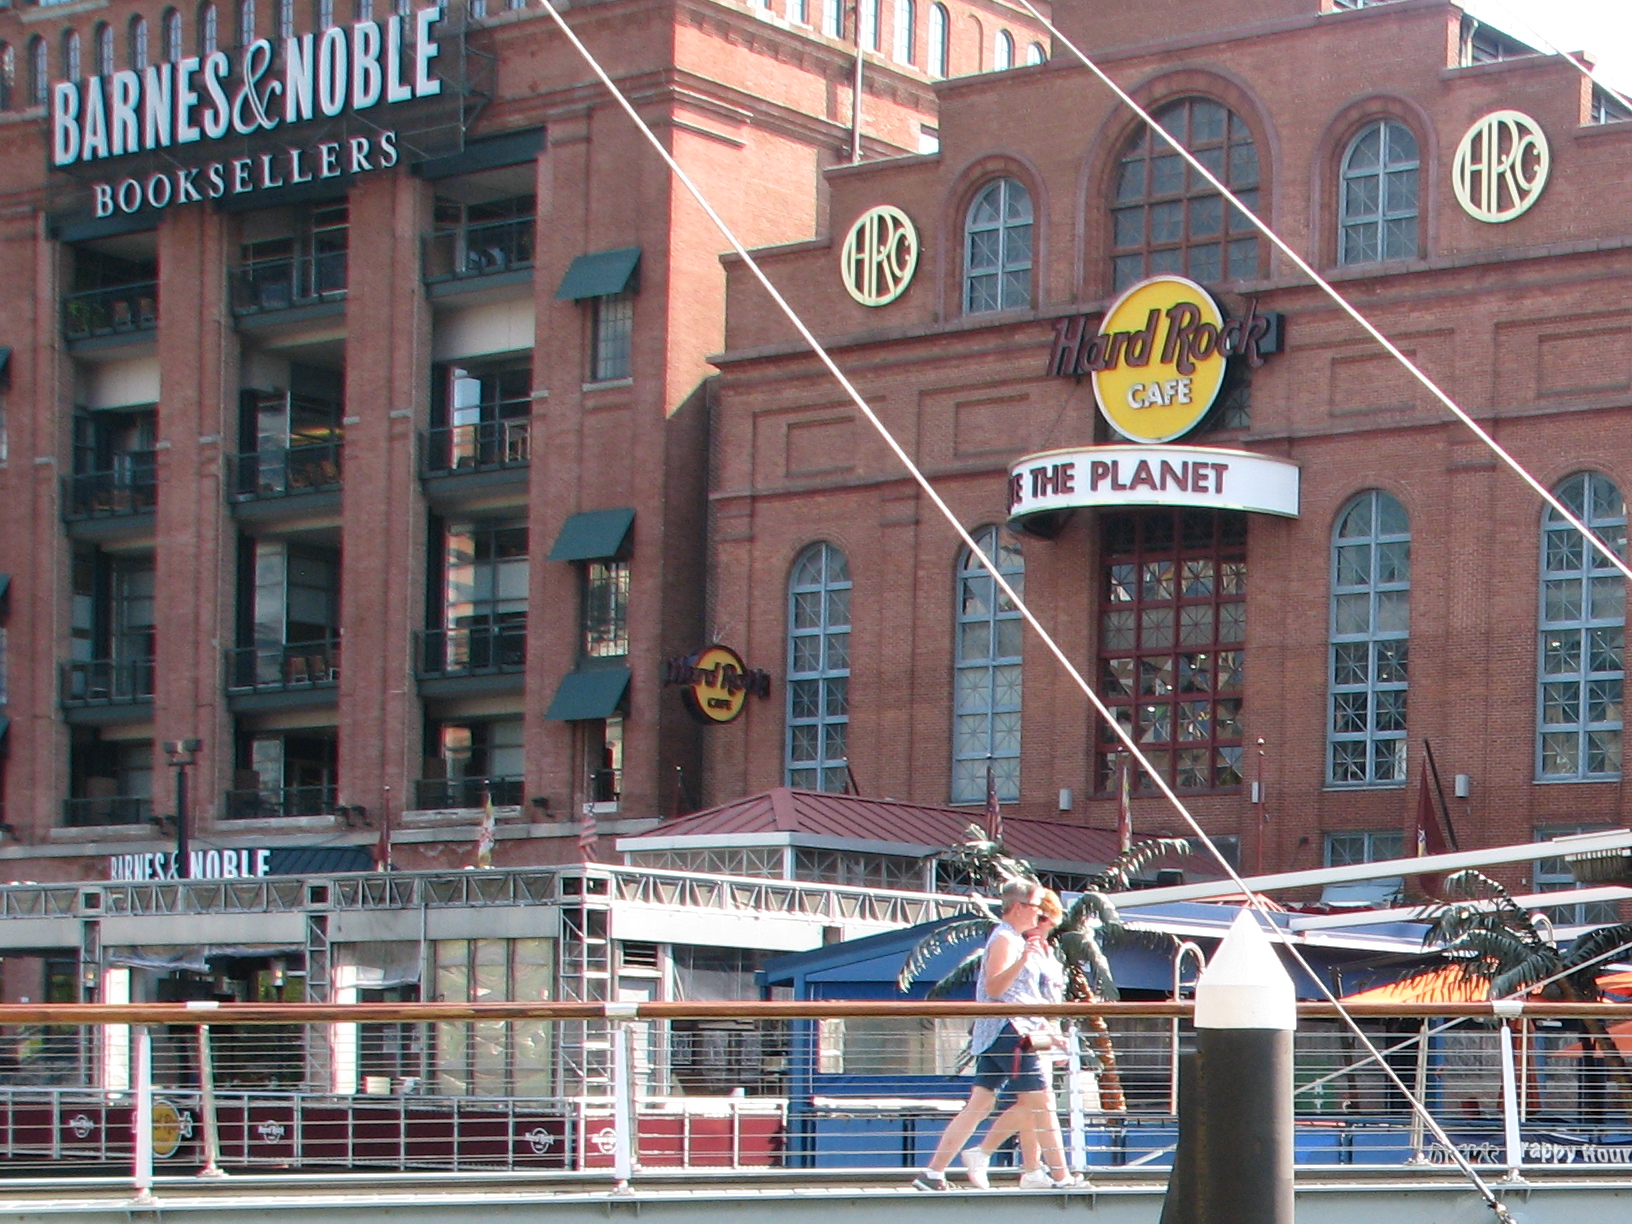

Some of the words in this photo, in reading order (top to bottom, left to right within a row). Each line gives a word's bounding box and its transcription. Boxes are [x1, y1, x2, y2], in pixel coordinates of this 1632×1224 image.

[94, 131, 399, 218] BOOKSELLERS
[1049, 308, 1161, 376] Hard
[1160, 299, 1268, 375] Rock
[1127, 377, 1192, 409] CAFE
[1029, 462, 1075, 498] THE
[1090, 459, 1229, 494] PLANET
[111, 851, 165, 881] BARNES
[190, 849, 271, 880] NOBLE
